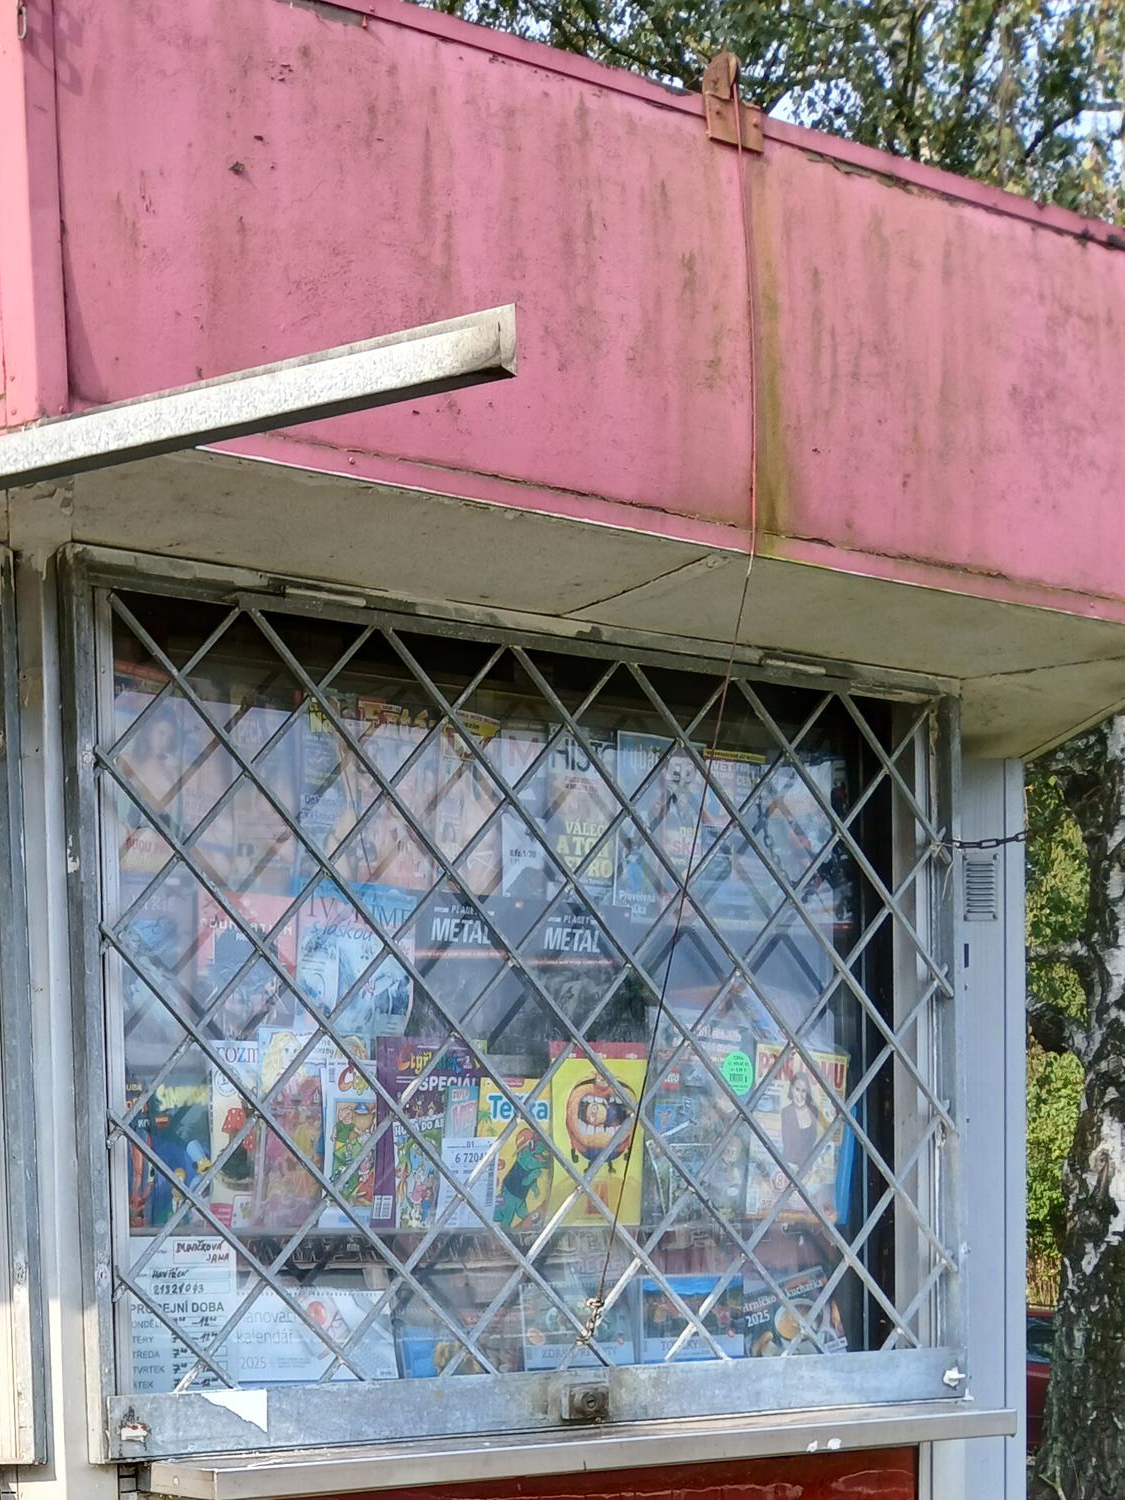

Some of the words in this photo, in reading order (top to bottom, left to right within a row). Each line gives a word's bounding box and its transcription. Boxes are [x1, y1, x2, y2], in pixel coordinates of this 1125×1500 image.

[431, 917, 492, 945] METAL
[543, 926, 601, 953] METAL
[191, 1301, 225, 1314] DOBA
[745, 1309, 771, 1327] 2025
[240, 1356, 267, 1369] 2025
